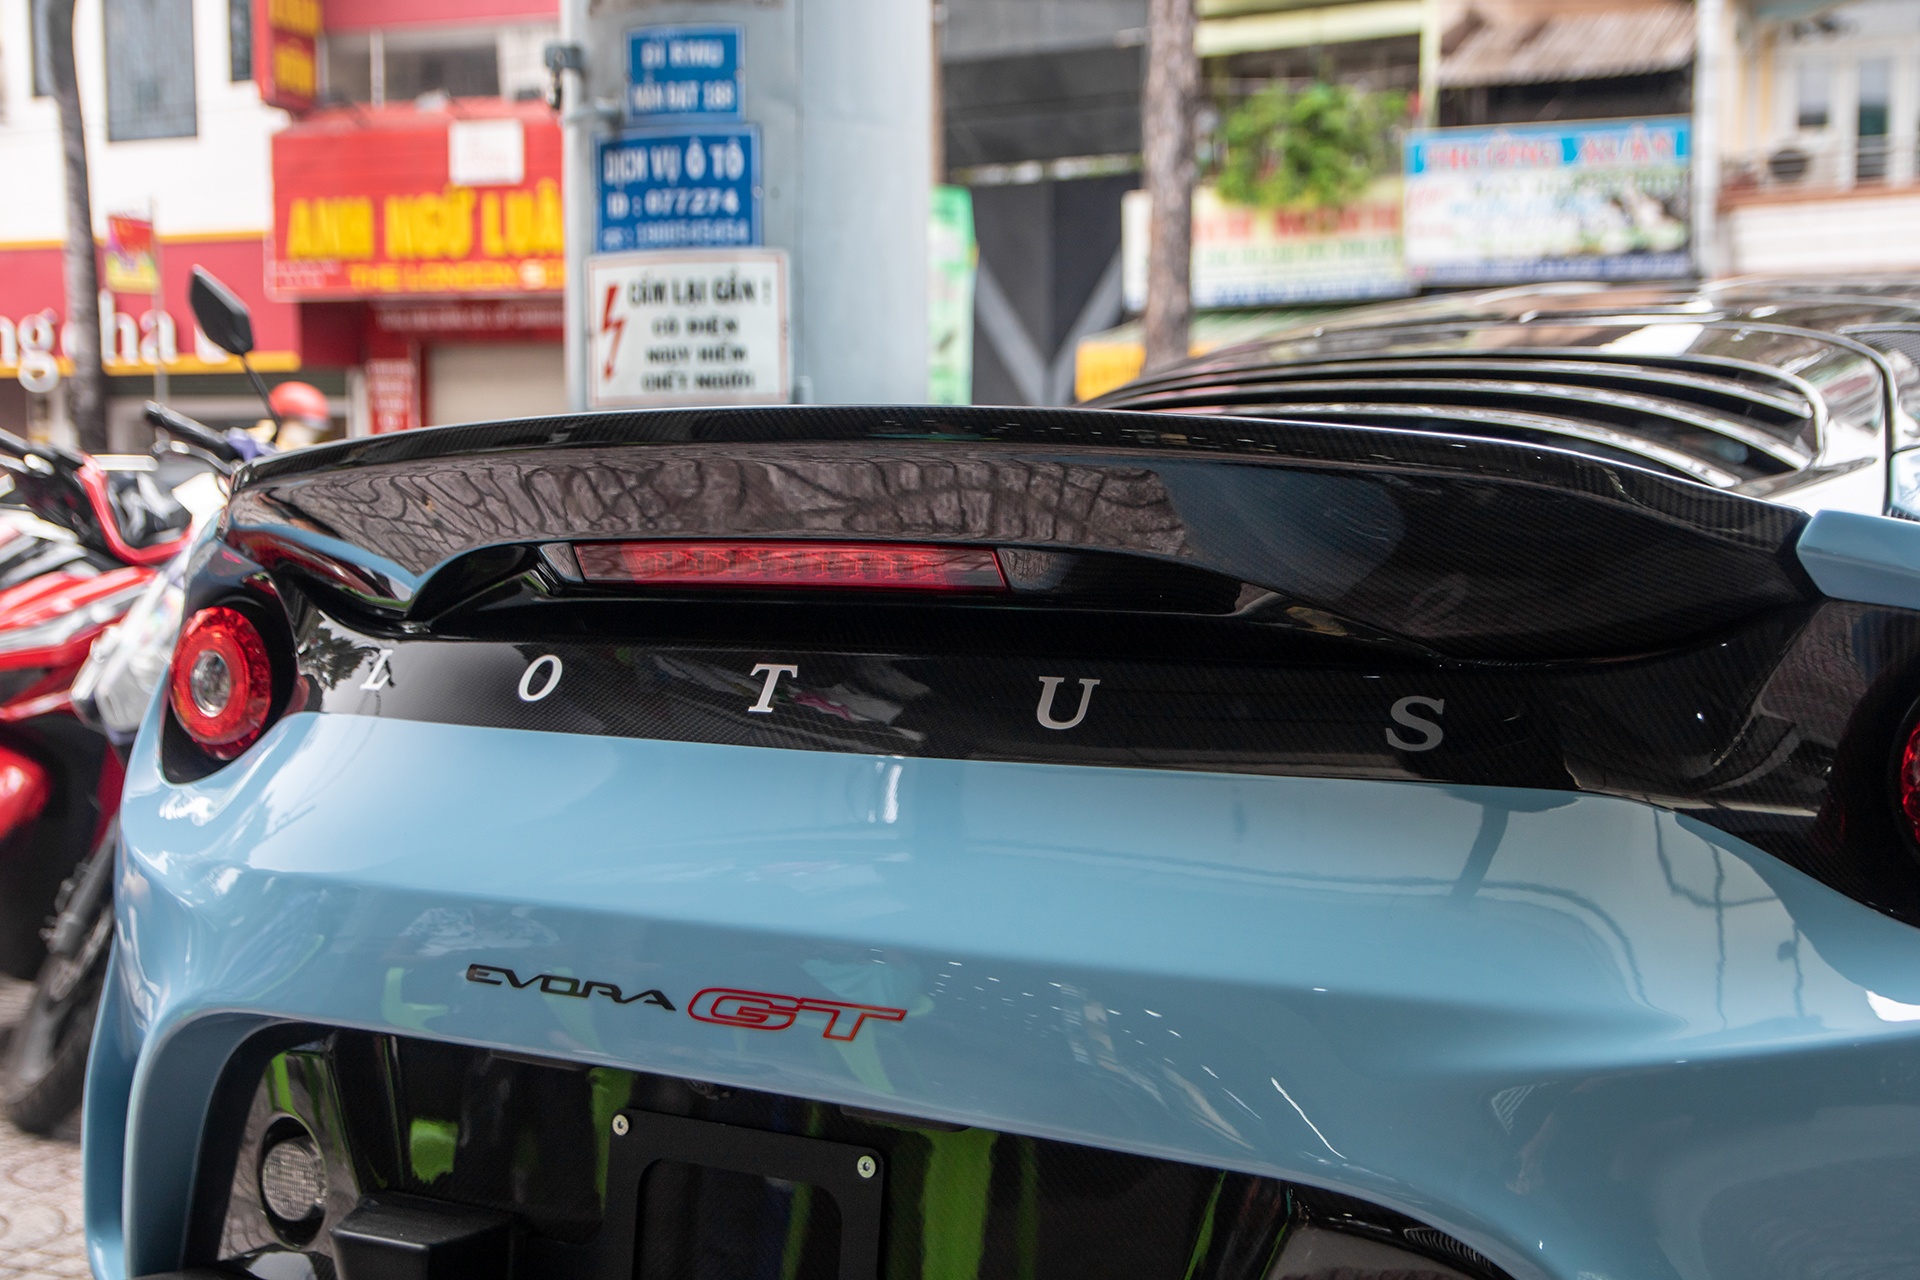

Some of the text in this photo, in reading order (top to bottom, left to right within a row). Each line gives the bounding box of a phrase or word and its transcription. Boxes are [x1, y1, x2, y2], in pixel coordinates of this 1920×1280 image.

[651, 144, 682, 187] VỤ
[685, 136, 706, 181] Ô
[709, 135, 745, 181] TÔ
[359, 648, 1446, 753] LOTUS
[465, 963, 908, 1042] EVORA GT
